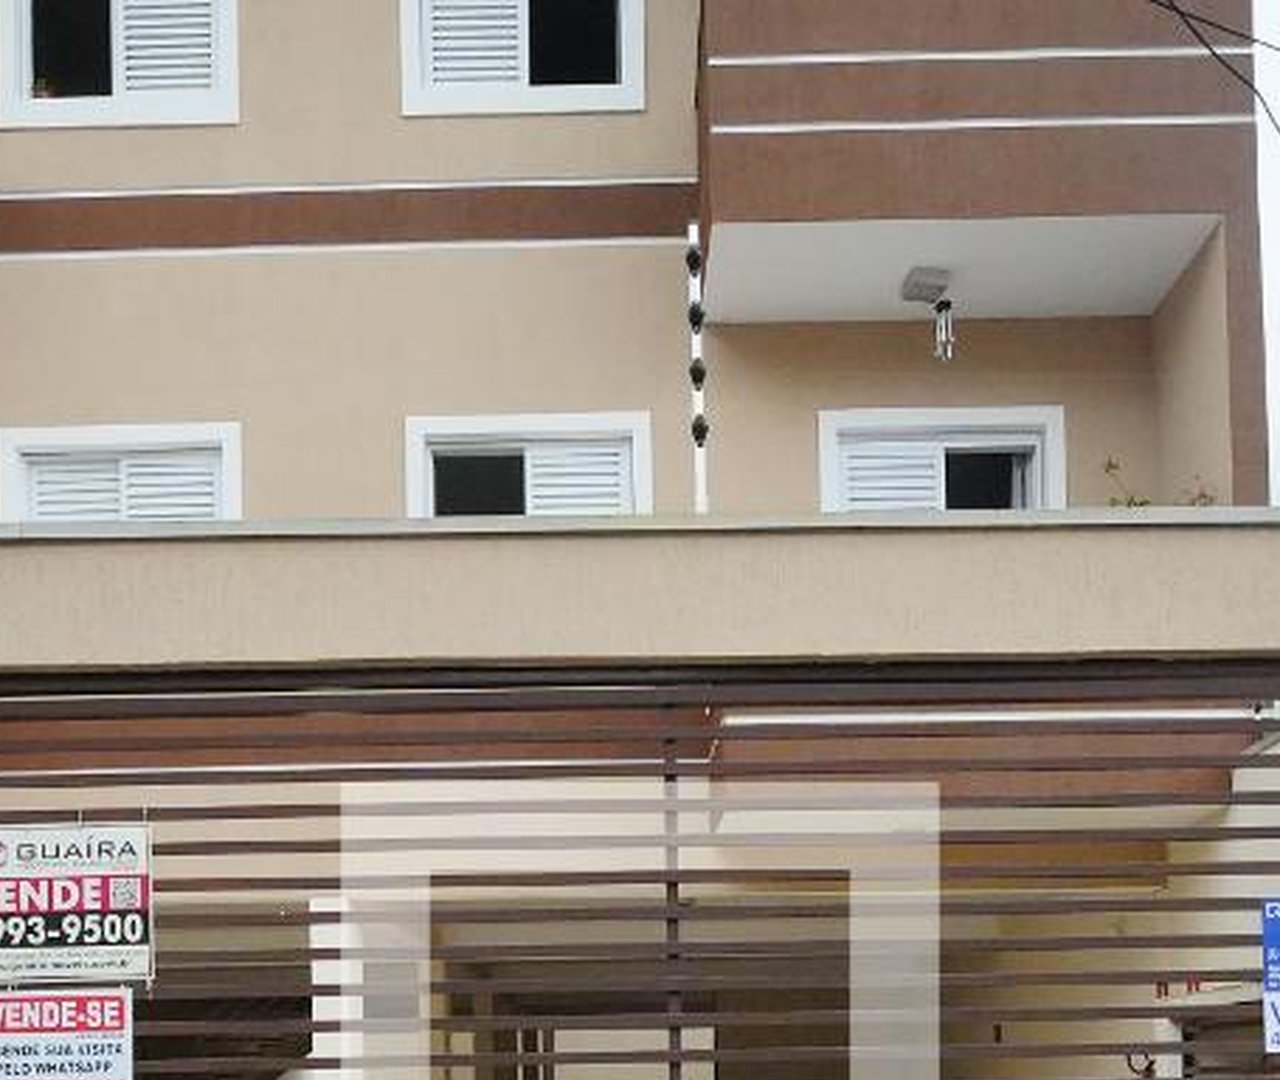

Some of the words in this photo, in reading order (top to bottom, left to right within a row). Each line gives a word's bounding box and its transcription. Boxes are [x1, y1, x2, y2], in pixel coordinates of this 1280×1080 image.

[16, 835, 137, 861] GUAÍRA
[44, 1043, 75, 1057] SUA
[35, 1060, 113, 1075] WHATSAPP
